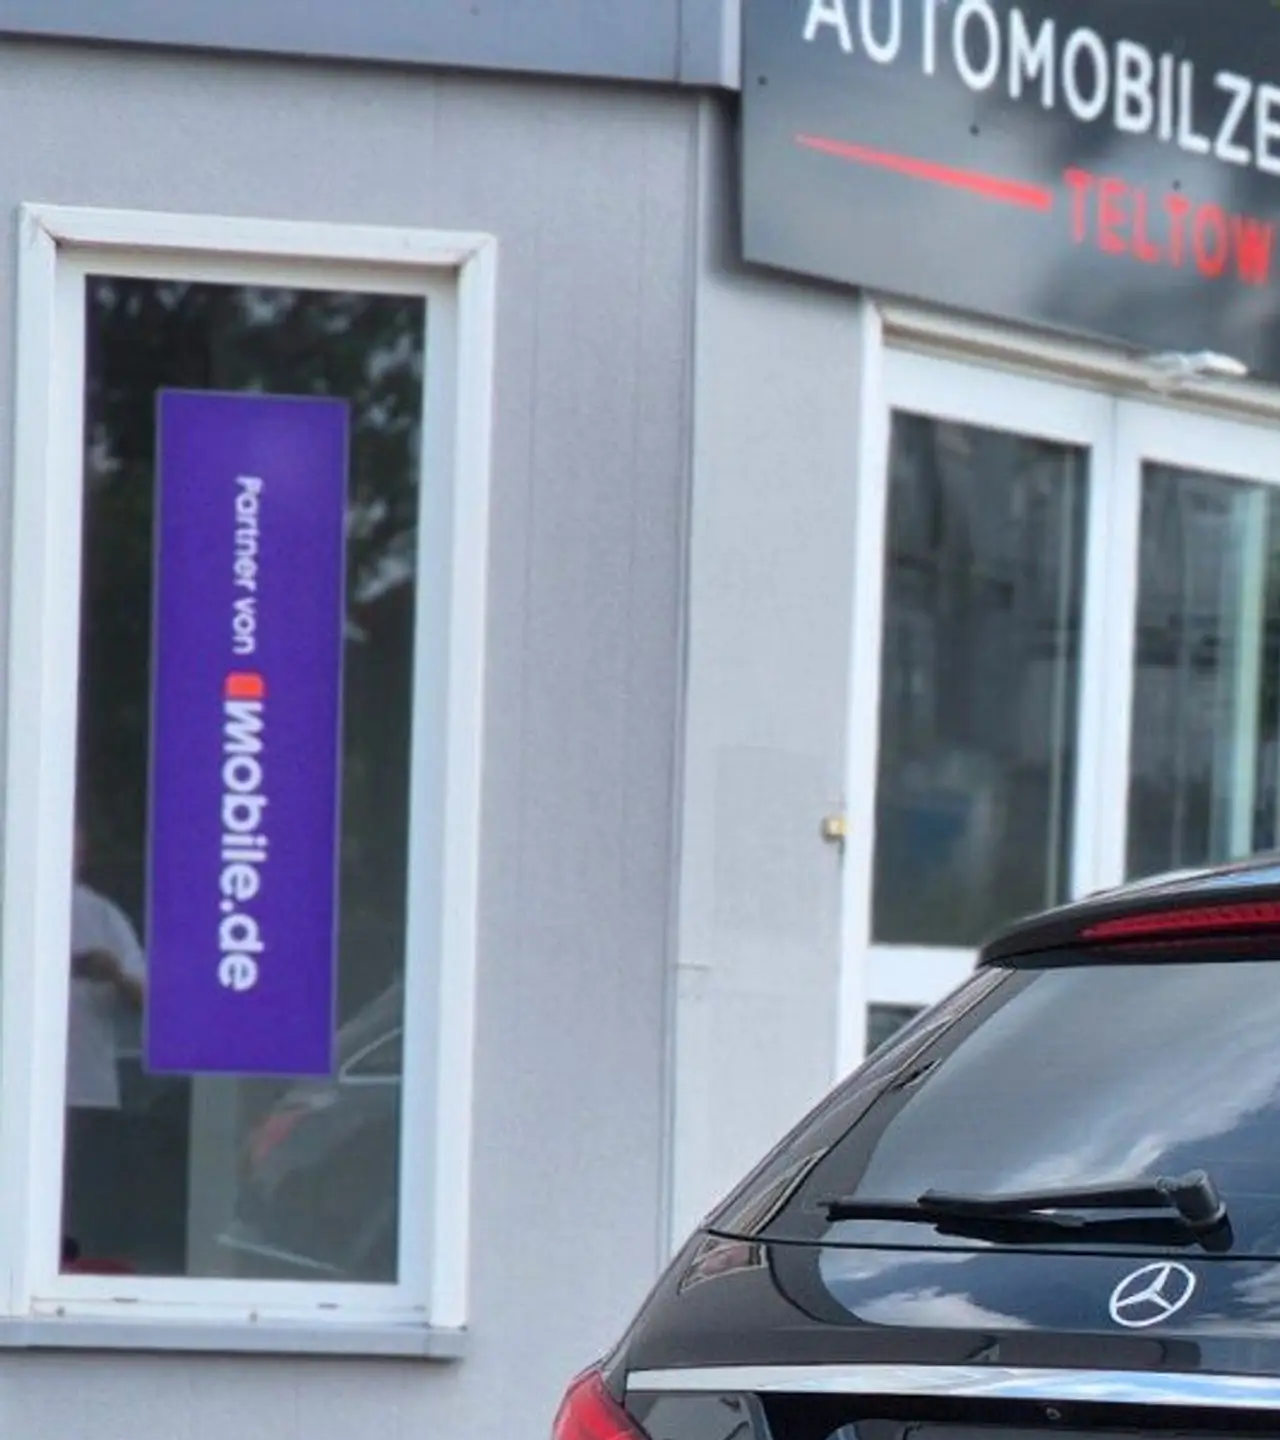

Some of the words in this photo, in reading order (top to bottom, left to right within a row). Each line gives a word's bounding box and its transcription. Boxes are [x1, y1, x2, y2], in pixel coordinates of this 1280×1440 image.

[1064, 168, 1276, 284] TELTOW
[234, 476, 262, 592] Partner
[233, 599, 256, 655] von
